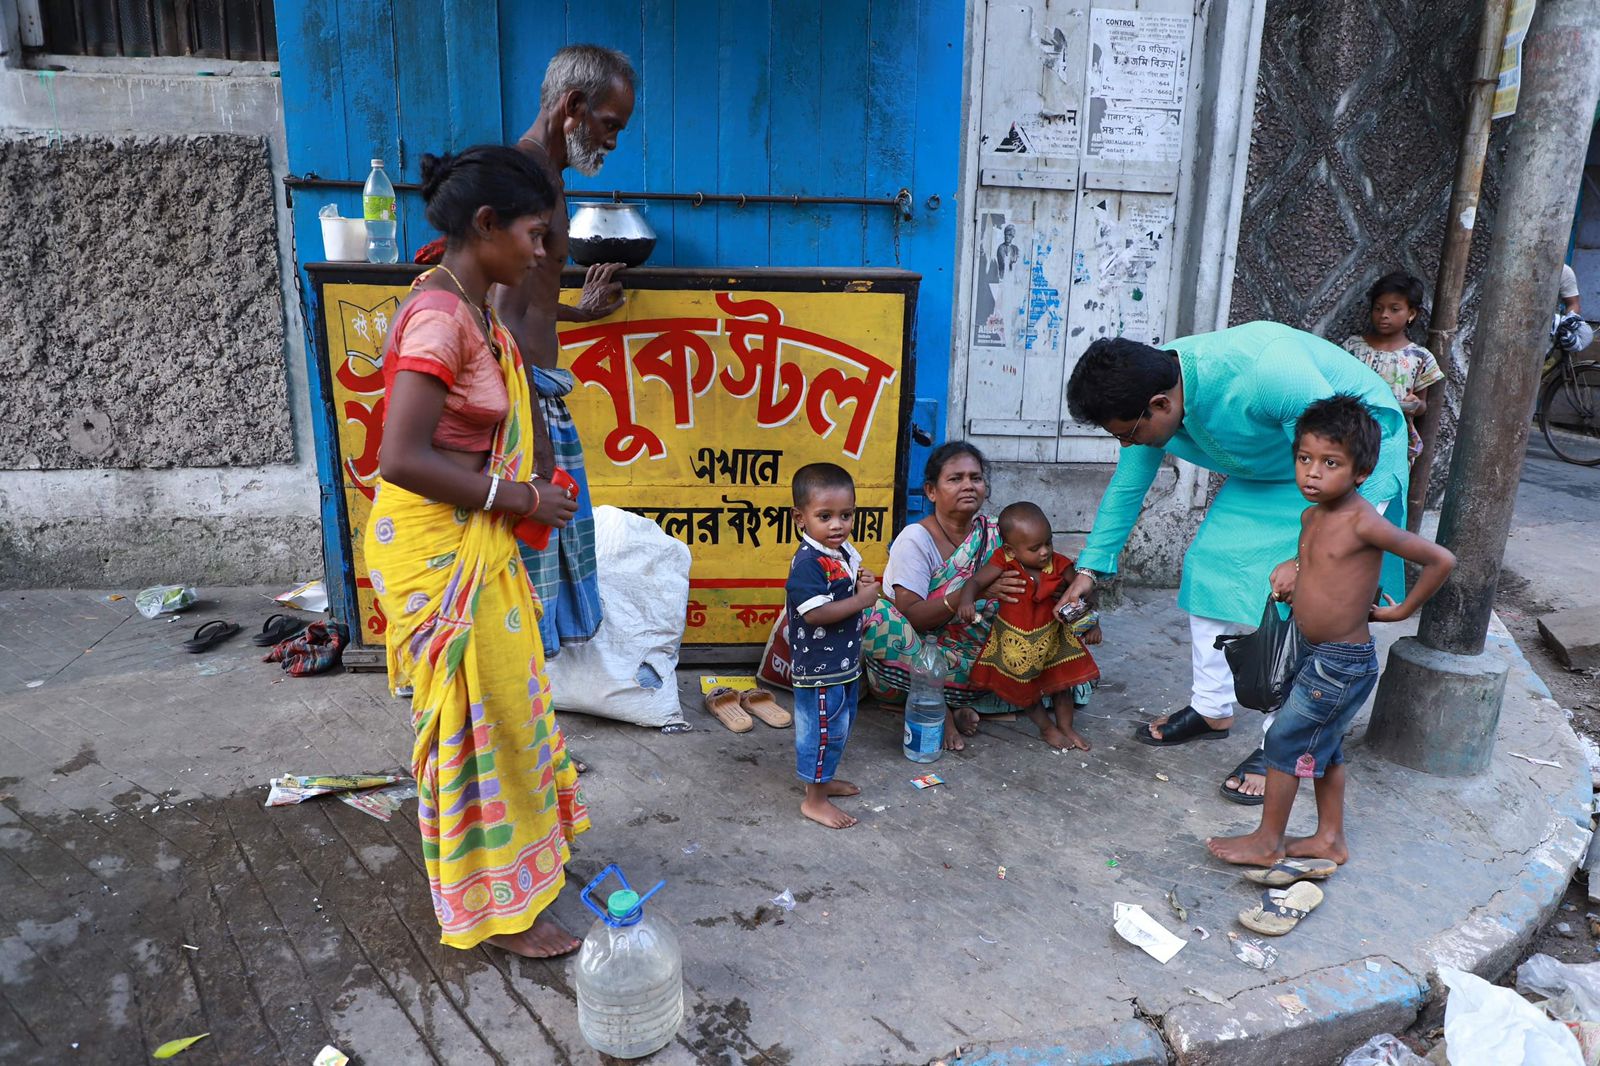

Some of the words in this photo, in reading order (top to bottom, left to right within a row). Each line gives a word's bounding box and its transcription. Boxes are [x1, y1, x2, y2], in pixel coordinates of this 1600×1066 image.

[1105, 18, 1135, 28] CONTROL
[352, 310, 370, 343] বই
[689, 447, 784, 486] এখানে
[762, 506, 803, 545] পা
